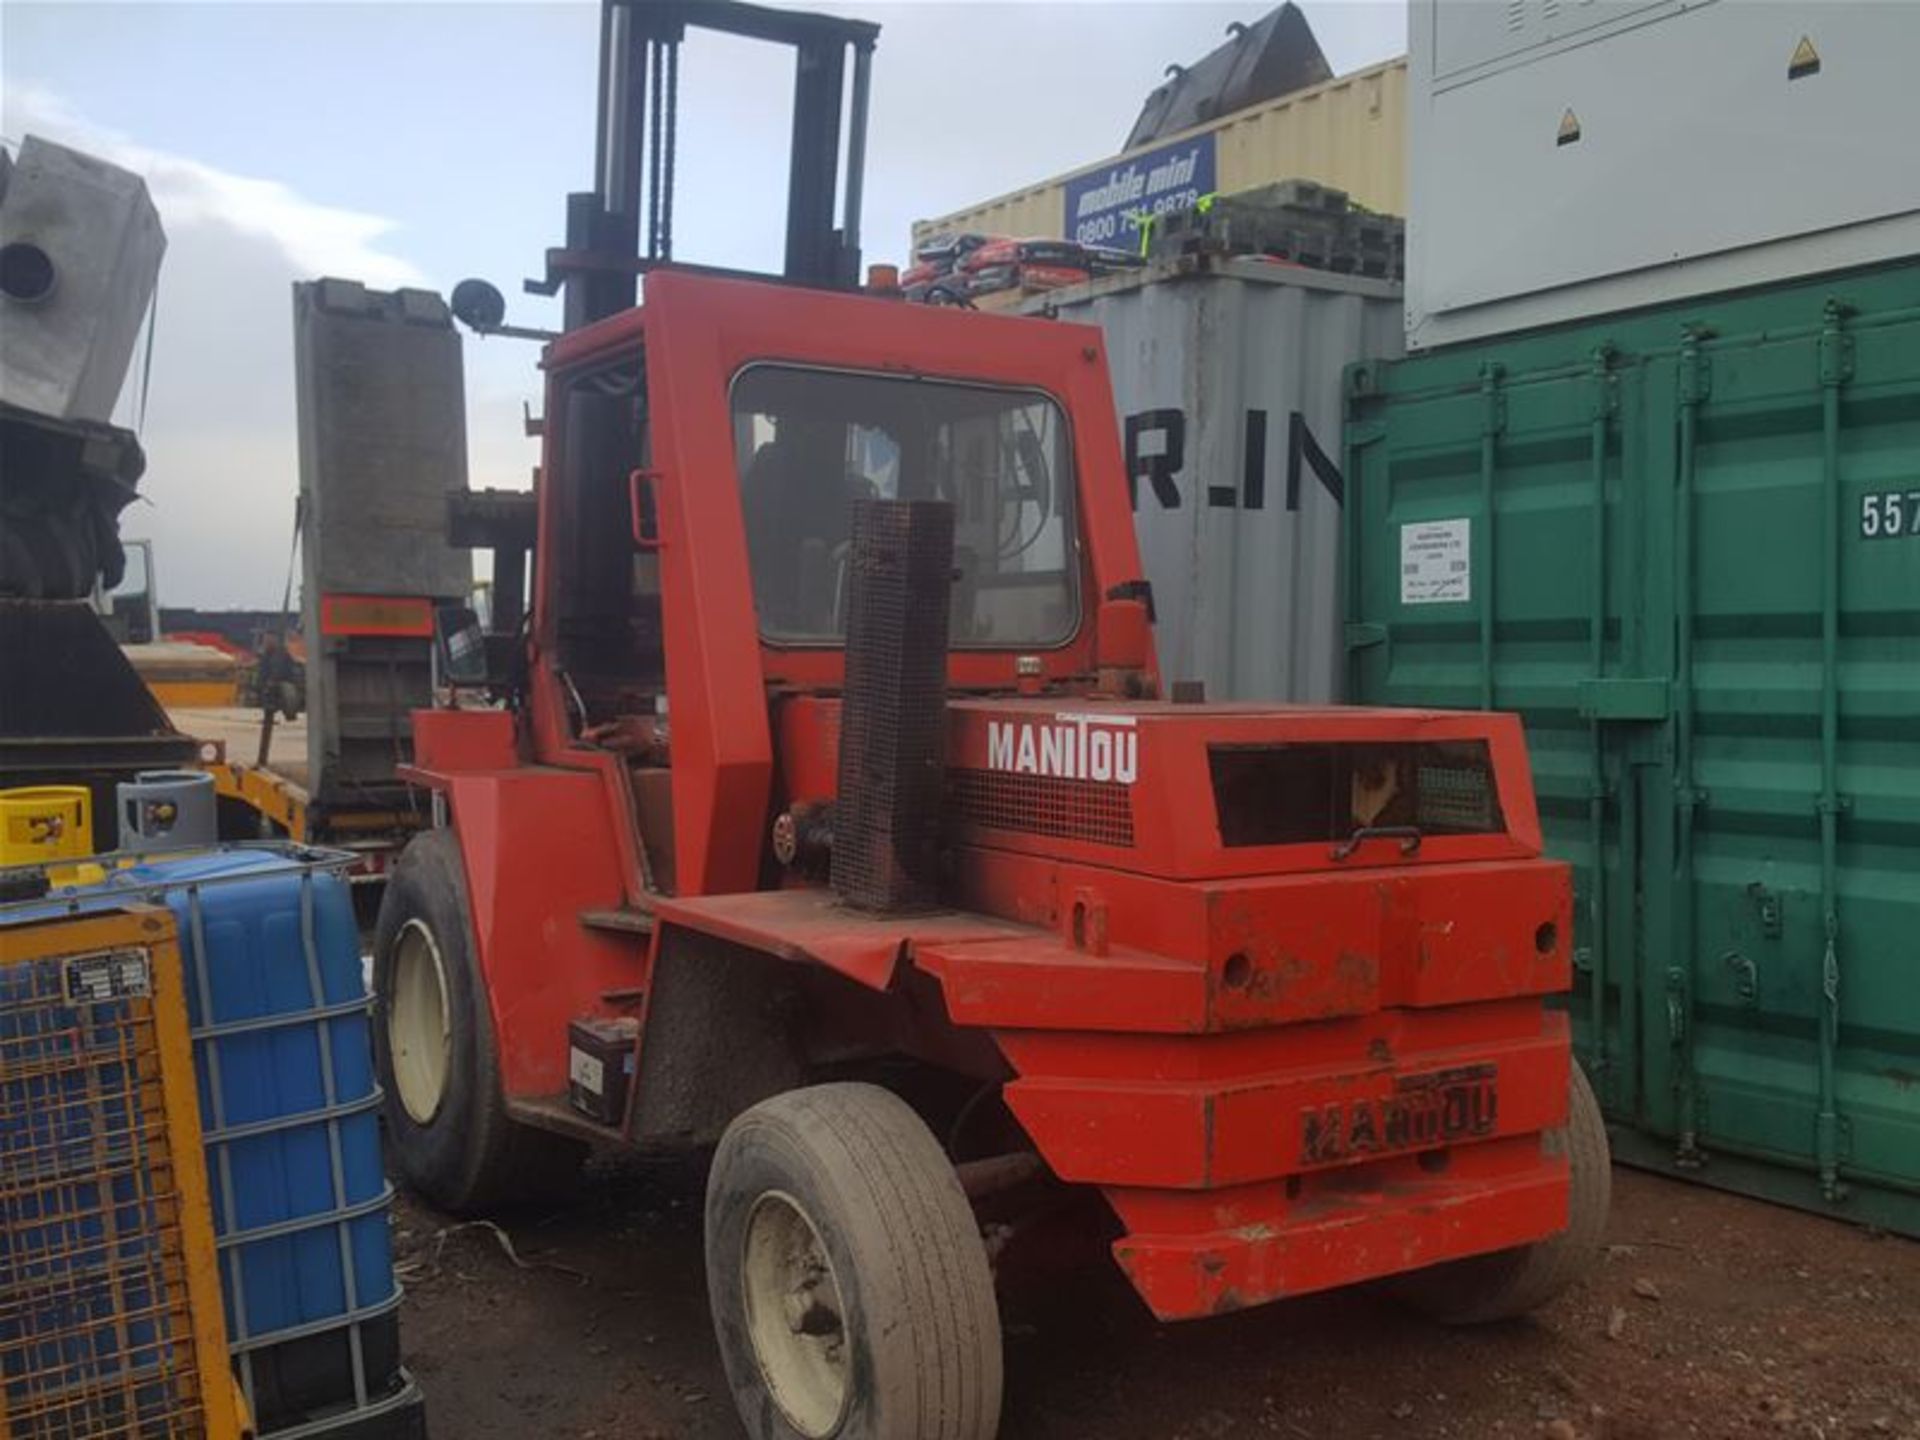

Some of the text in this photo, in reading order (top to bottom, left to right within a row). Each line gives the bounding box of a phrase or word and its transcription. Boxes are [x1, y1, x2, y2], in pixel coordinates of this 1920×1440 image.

[1077, 149, 1199, 218] mobile mini
[1077, 213, 1115, 246] 0800
[988, 712, 1137, 783] MANITOU
